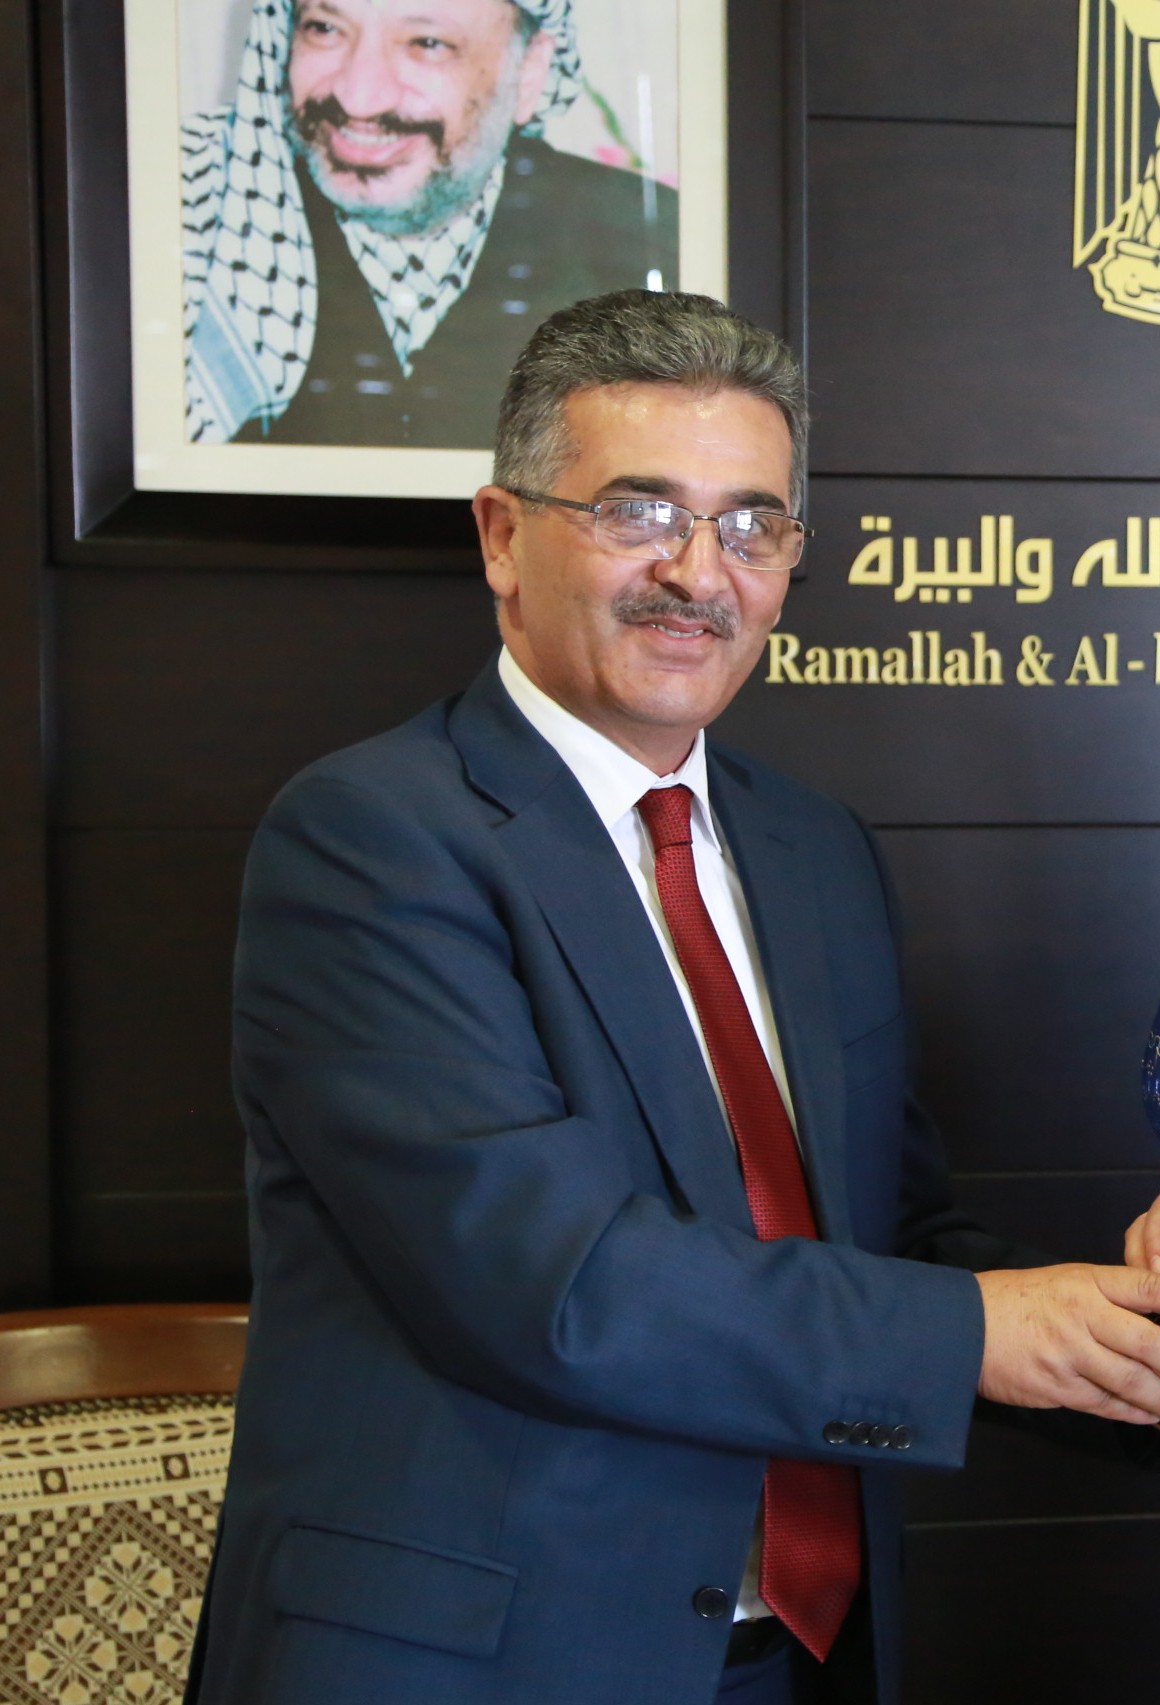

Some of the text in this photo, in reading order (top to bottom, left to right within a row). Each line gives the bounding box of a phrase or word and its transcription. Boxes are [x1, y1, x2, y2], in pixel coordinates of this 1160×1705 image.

[848, 514, 1053, 603] والبيرة
[765, 630, 1005, 687] Ramallah
[1016, 634, 1056, 687] &
